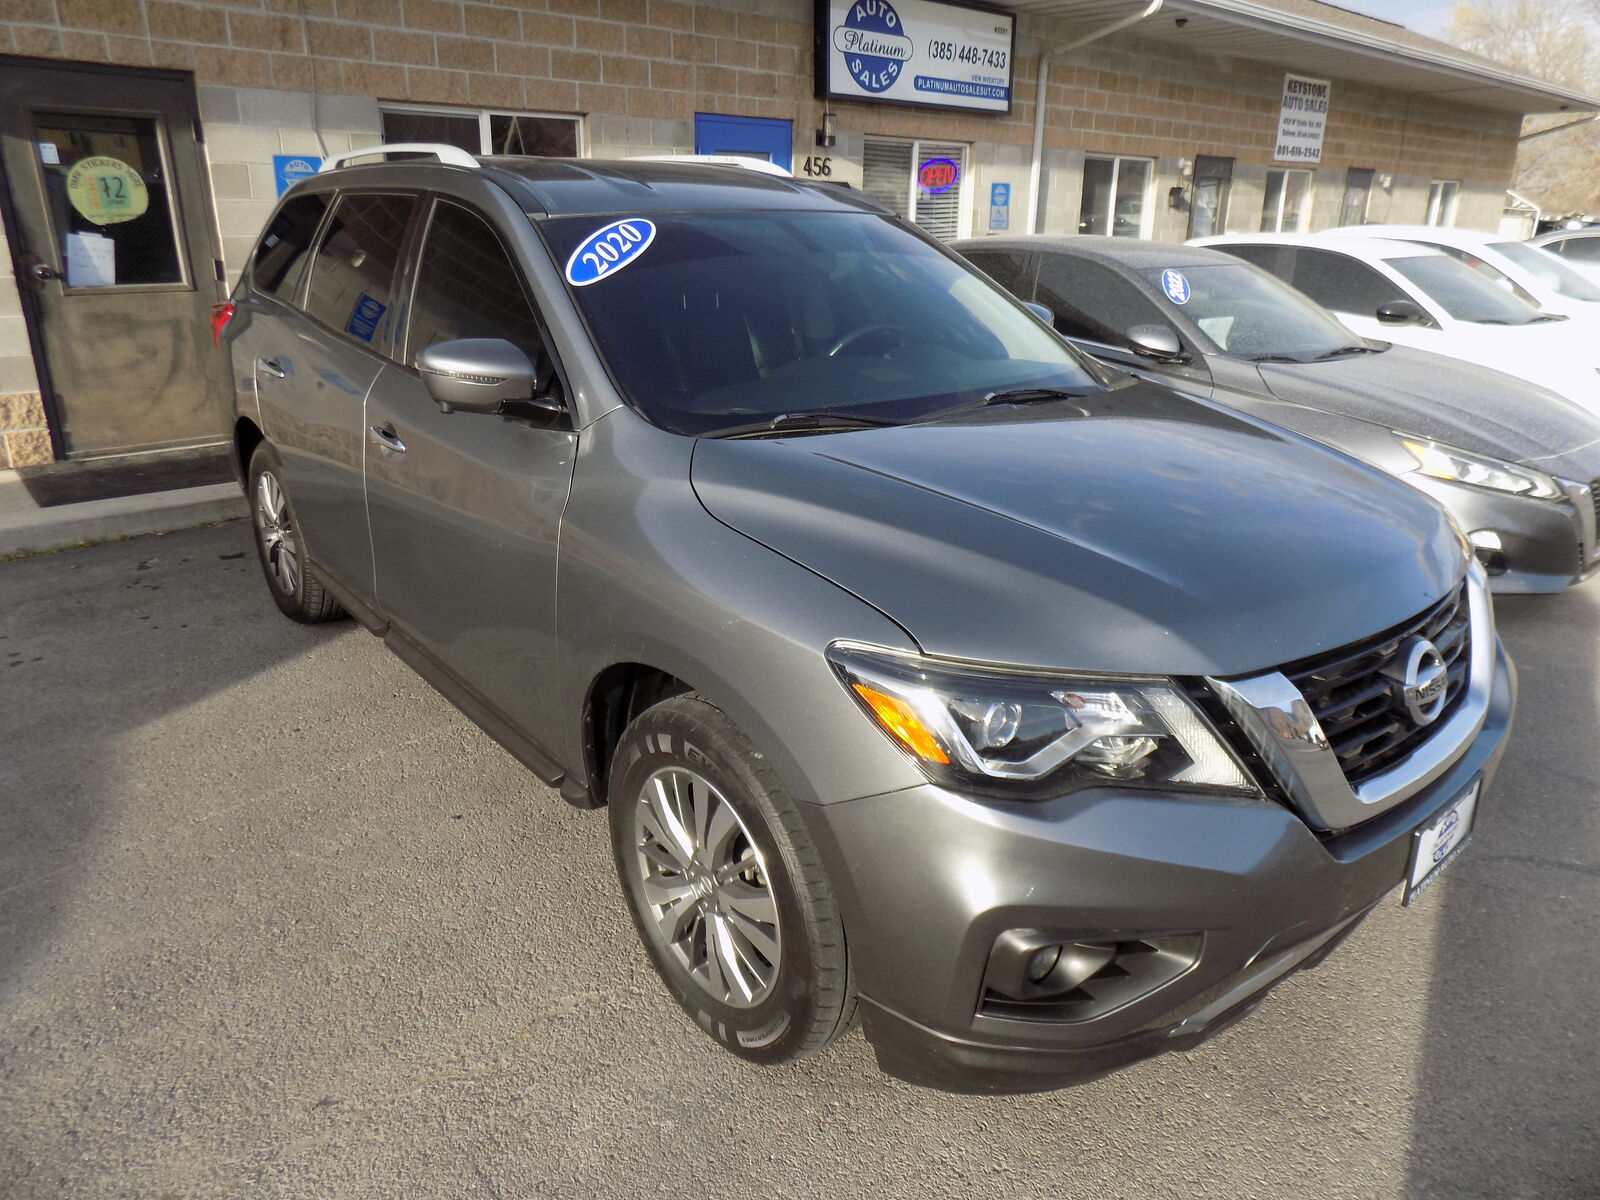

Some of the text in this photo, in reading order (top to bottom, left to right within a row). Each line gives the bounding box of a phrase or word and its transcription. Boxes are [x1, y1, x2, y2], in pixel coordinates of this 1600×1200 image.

[855, 0, 897, 28] AUTO
[844, 30, 907, 58] Platinum
[928, 39, 1007, 70] (385) 448-7433
[851, 58, 898, 88] SALES
[917, 78, 1005, 98] PLATINUMAUTOSALESUT.COM
[1287, 79, 1327, 98] KEYSTONE
[1283, 95, 1328, 114] AUTO SALES
[1276, 144, 1321, 159] 801-616-2542
[70, 169, 82, 190] DMV
[81, 157, 124, 171] STICKERS
[289, 160, 310, 170] AUTO
[803, 156, 832, 176] 456
[919, 164, 955, 187] OPEN
[100, 176, 127, 199] 12
[582, 223, 642, 276] 2020
[1415, 677, 1447, 701] NISSA
